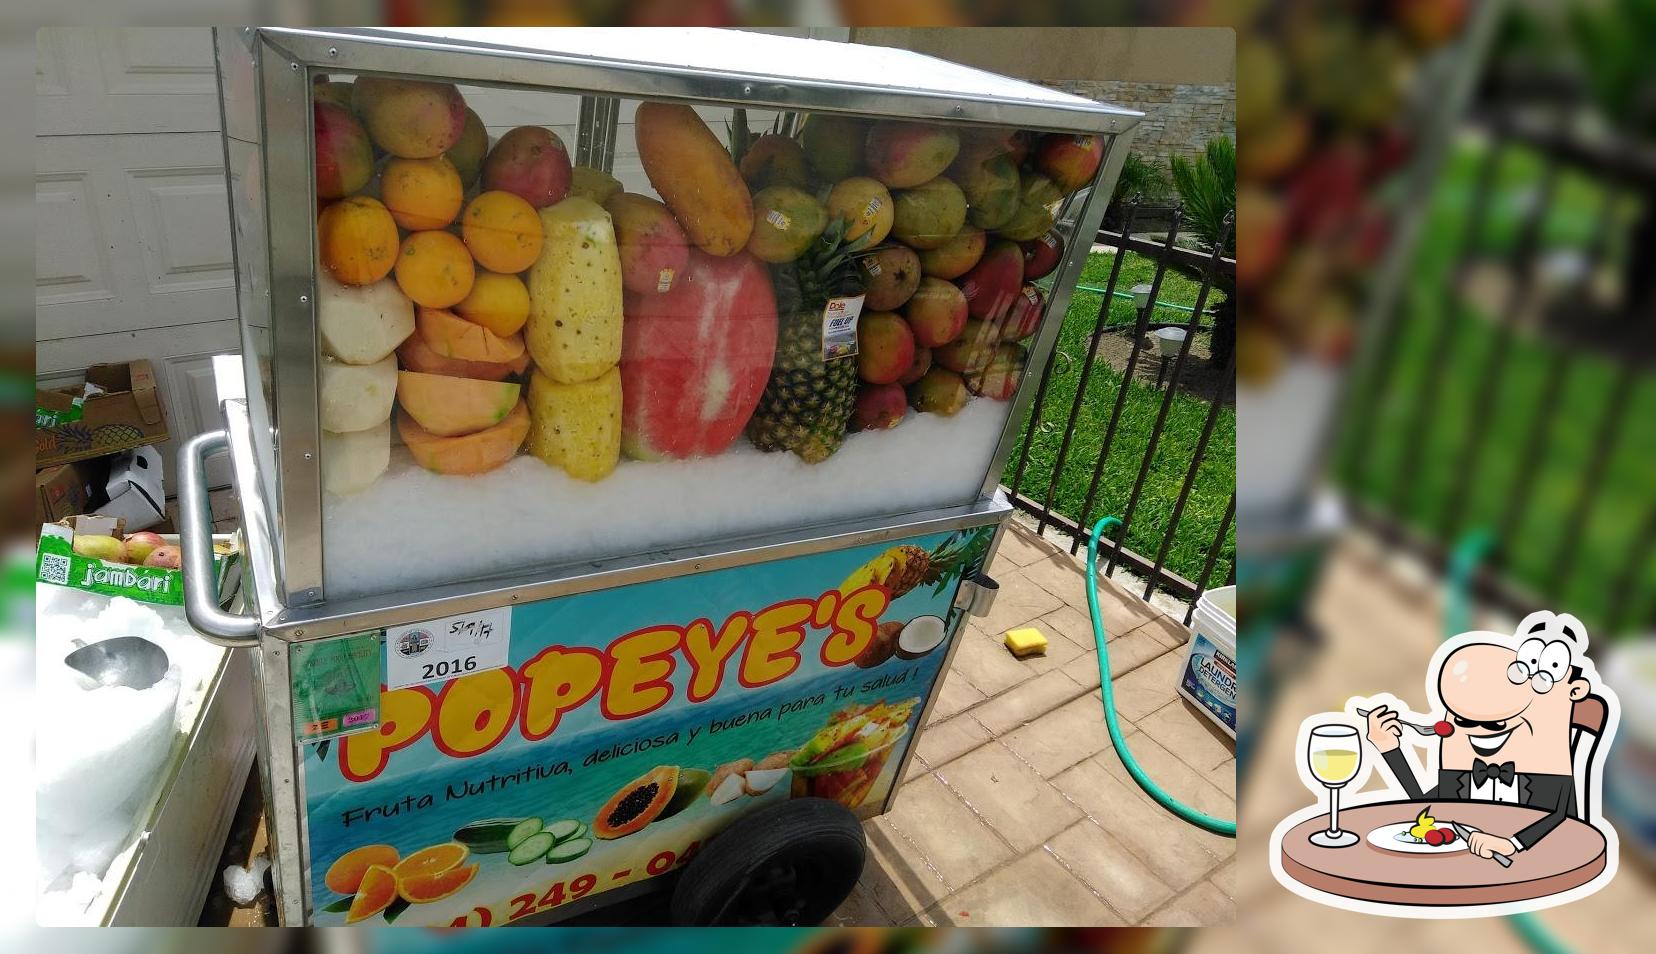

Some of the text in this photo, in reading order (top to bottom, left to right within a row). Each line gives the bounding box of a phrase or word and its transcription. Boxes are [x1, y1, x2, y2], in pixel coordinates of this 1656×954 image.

[829, 302, 846, 310] Dole
[81, 563, 171, 593] jambari
[338, 585, 891, 782] POPEYE'S
[422, 655, 477, 680] 2016
[341, 793, 434, 828] Fruta
[445, 760, 574, 801] Nutritiva,
[582, 731, 680, 768] deliciosa
[686, 726, 702, 746] y
[709, 707, 773, 736] buena
[777, 691, 825, 722] para
[833, 684, 855, 702] tu
[509, 874, 598, 920] 249
